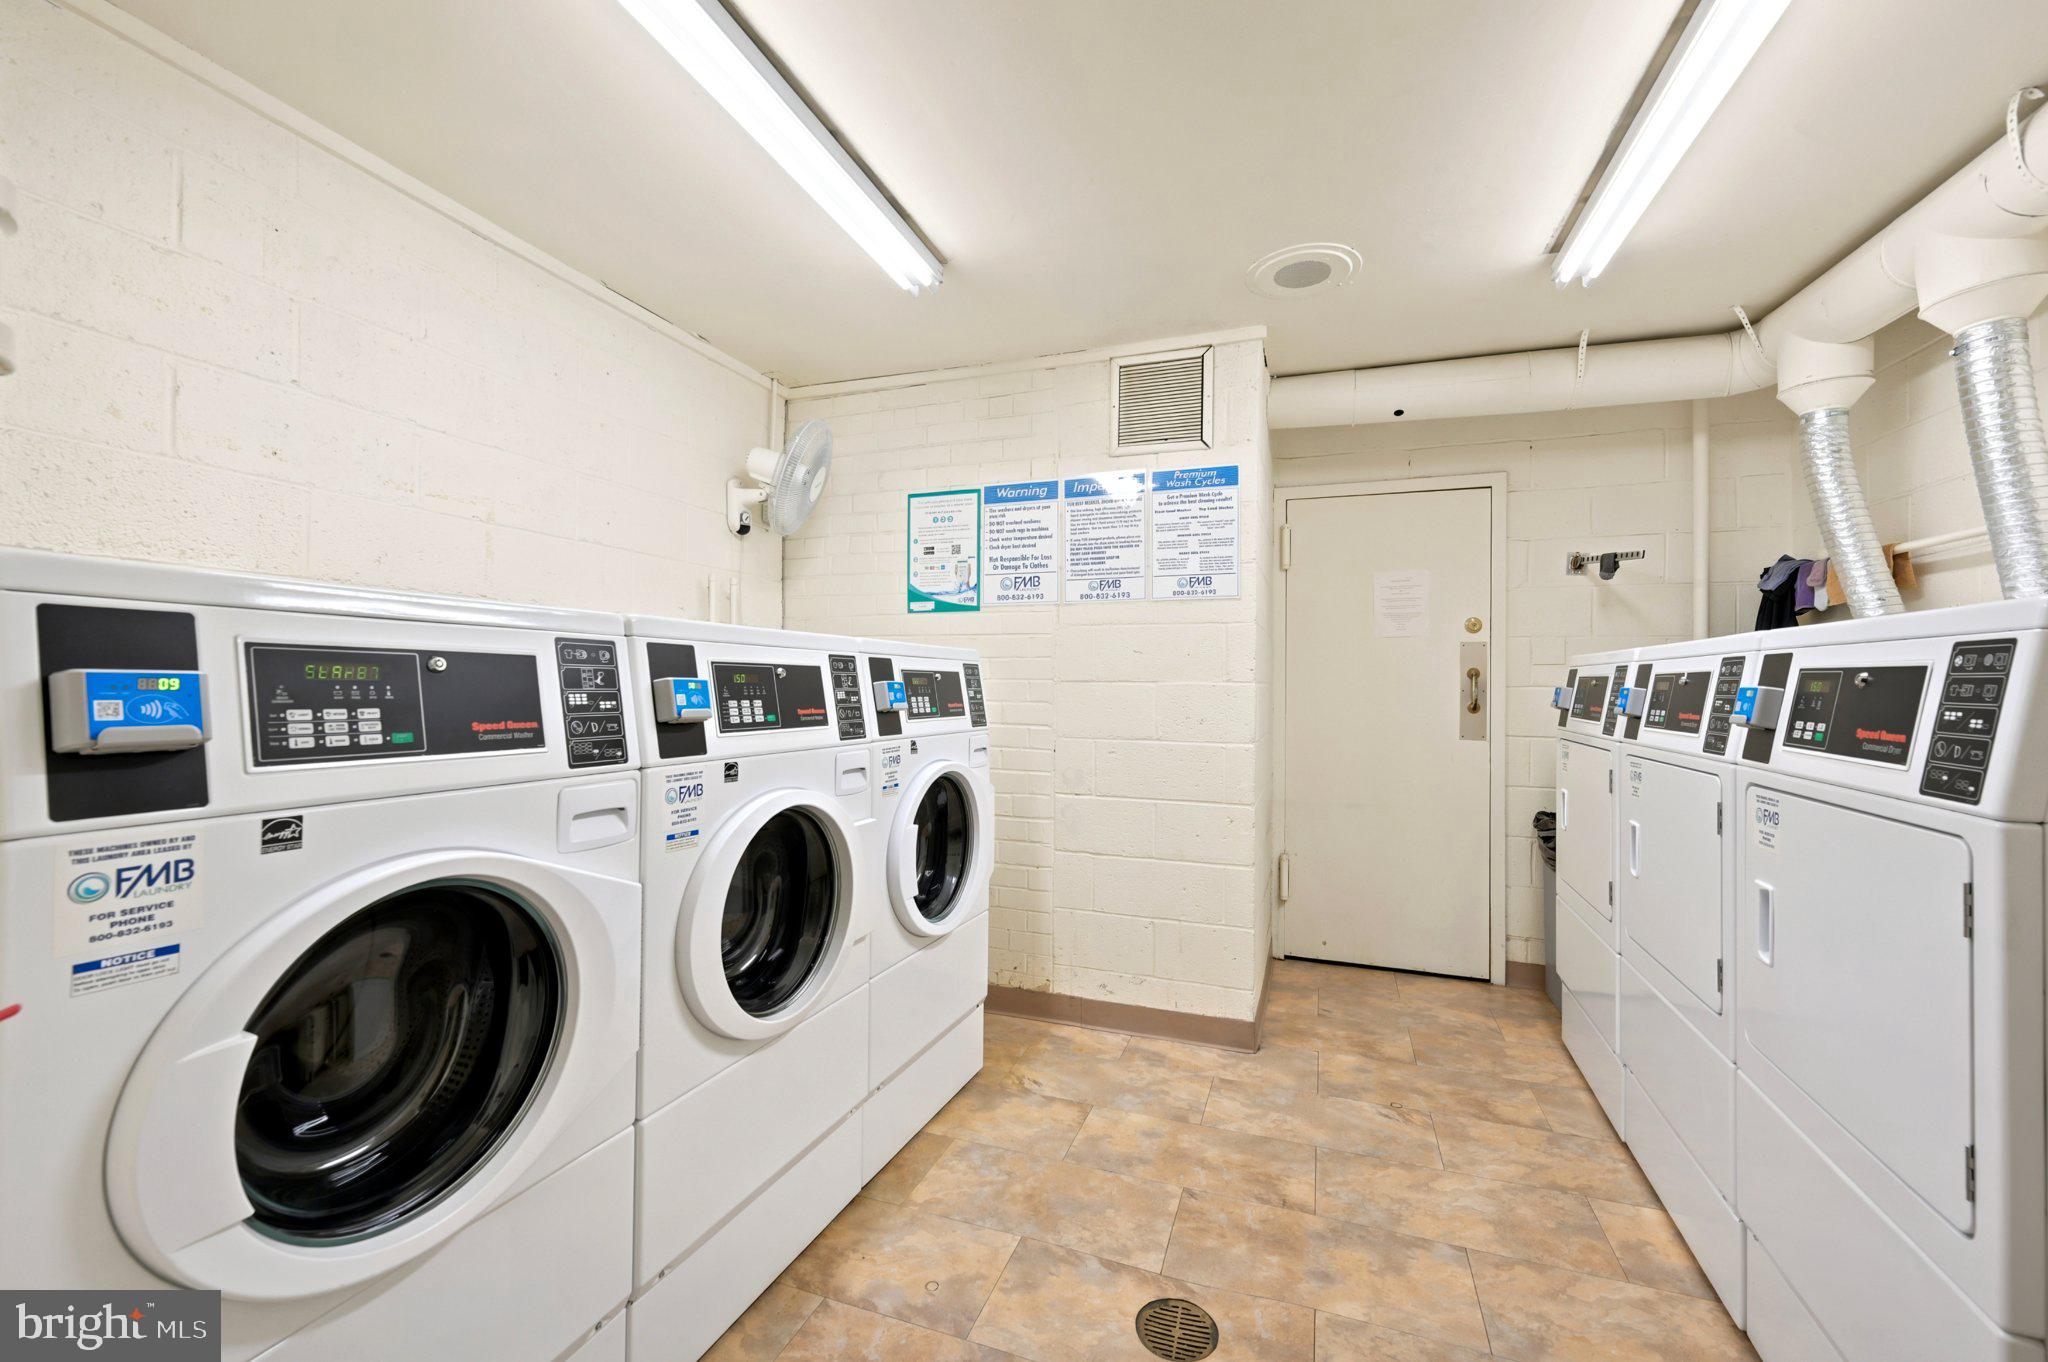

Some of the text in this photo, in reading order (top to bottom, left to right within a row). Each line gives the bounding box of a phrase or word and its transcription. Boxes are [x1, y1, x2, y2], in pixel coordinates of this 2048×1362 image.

[1174, 469, 1217, 479] Premium
[1166, 476, 1225, 487] Wash Cycles
[996, 485, 1048, 498] Warning
[999, 554, 1030, 563] Responsible
[1014, 575, 1041, 591] FMB
[1099, 579, 1122, 591] FMB
[1189, 576, 1213, 588] FMB
[997, 593, 1044, 601] 800-832-6193
[1080, 592, 1131, 600] 800-832-6193
[471, 720, 538, 732] Speed Queen
[478, 733, 512, 741] Commercial
[1856, 728, 1880, 740] Speed
[679, 783, 704, 804] FMB
[1763, 808, 1780, 826] FMB
[68, 834, 196, 857] THESE MACHINES OWNED BY AND
[71, 857, 90, 865] THIS
[92, 851, 129, 863] LAUNDRY
[131, 849, 151, 857] AREA
[153, 845, 180, 854] LEASED
[115, 858, 195, 899] FMB
[133, 882, 193, 899] LAUNDRY
[89, 900, 175, 922] FOR SERVICE
[109, 914, 156, 929] PHONE
[89, 920, 174, 943] 800-832-6193
[100, 949, 156, 968] NOTICE
